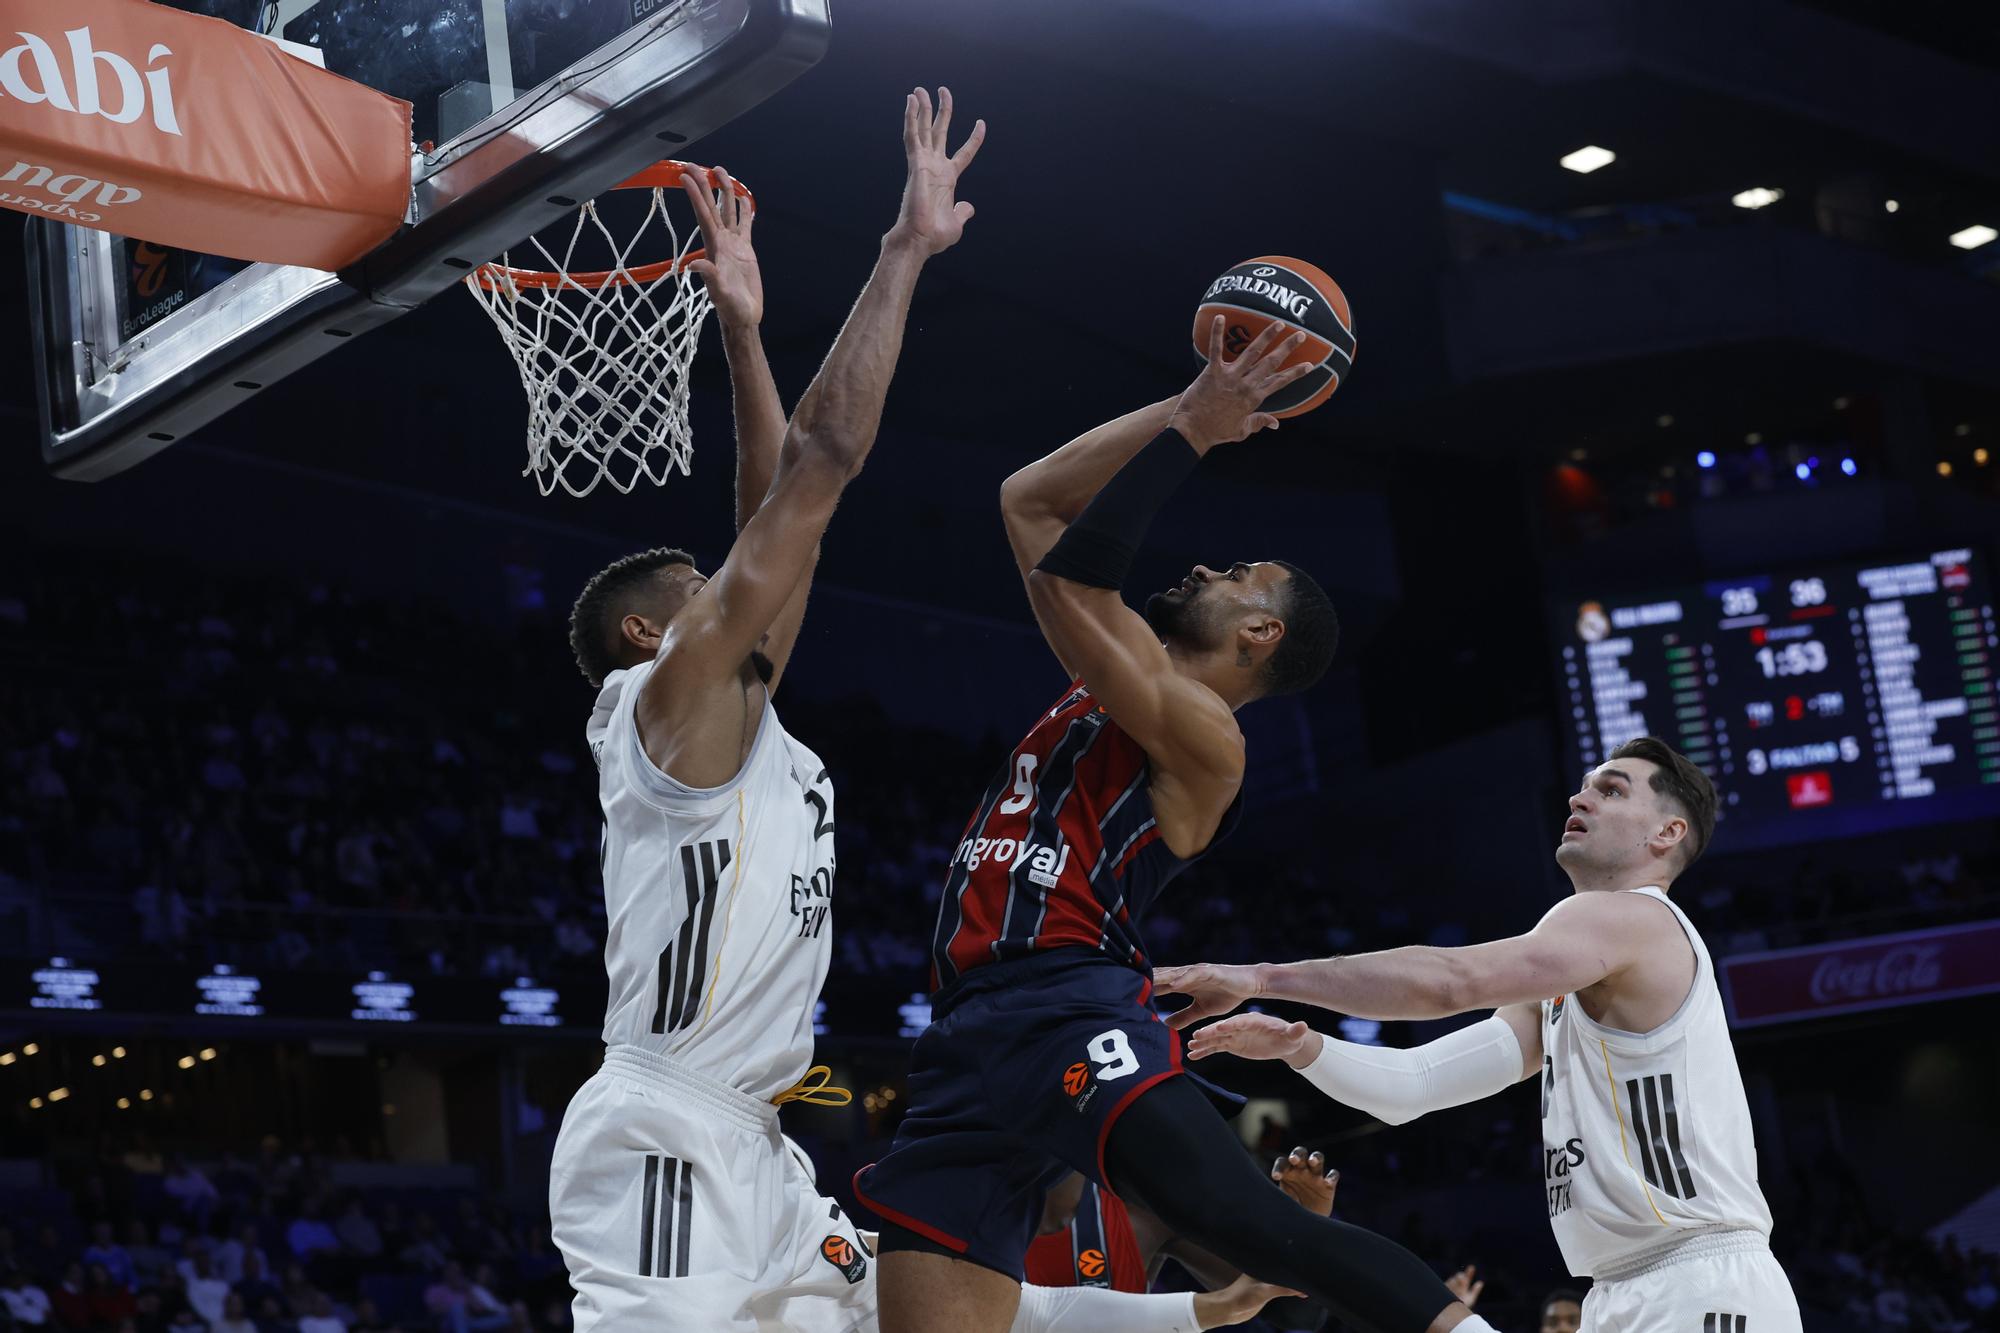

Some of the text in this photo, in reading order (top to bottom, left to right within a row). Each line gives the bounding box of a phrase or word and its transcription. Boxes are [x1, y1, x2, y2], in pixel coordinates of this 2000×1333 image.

[0, 26, 182, 136] abi
[0, 161, 142, 207] abu
[123, 289, 184, 335] EuroLeague
[1206, 275, 1314, 324] SPALDING
[1755, 640, 1828, 678] 1:53
[1000, 753, 1038, 814] 9
[1746, 749, 1768, 775] 3
[949, 836, 1070, 876] ngroyal
[1086, 1028, 1141, 1081] 9
